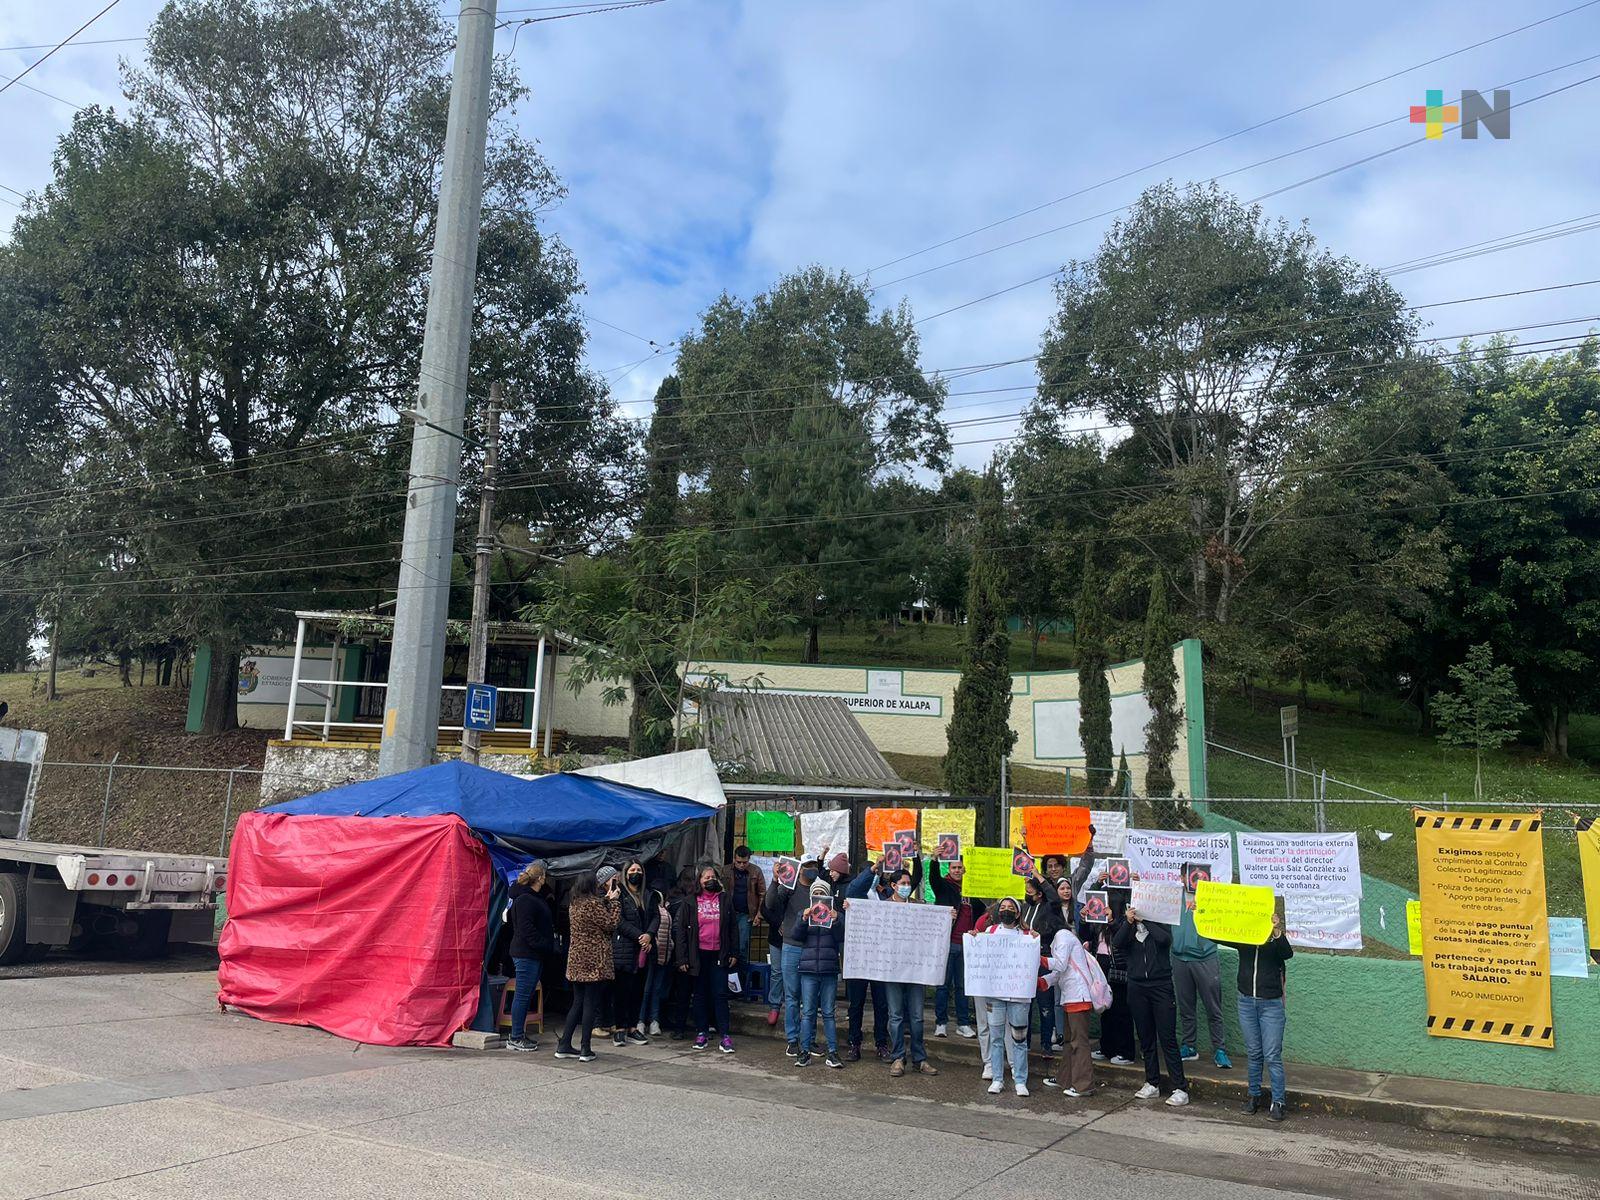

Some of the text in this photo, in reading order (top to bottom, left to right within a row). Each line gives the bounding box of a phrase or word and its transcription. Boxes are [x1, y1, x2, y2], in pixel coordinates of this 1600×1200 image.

[844, 697, 931, 710] SUPERIOR DE XALAPA
[1154, 836, 1177, 846] Walter
[1198, 839, 1208, 848] del
[1211, 839, 1229, 848] ITSX
[1243, 839, 1274, 847] Exigimos
[1140, 847, 1145, 856] Y
[1147, 848, 1164, 857] Todo
[1177, 850, 1208, 860] personal
[1438, 848, 1482, 856] Exigimos
[1152, 860, 1182, 869] confianz
[1494, 858, 1528, 867] Contrato
[1436, 865, 1471, 874] Colectivo
[1464, 876, 1503, 884] Defunción
[1449, 893, 1473, 902] Apoyo
[1434, 918, 1465, 926] Exigimos
[1435, 953, 1485, 962] pertenece
[1448, 963, 1511, 975] trabajadores
[1462, 974, 1510, 984] SALARIO.
[1451, 990, 1473, 998] PAGO
